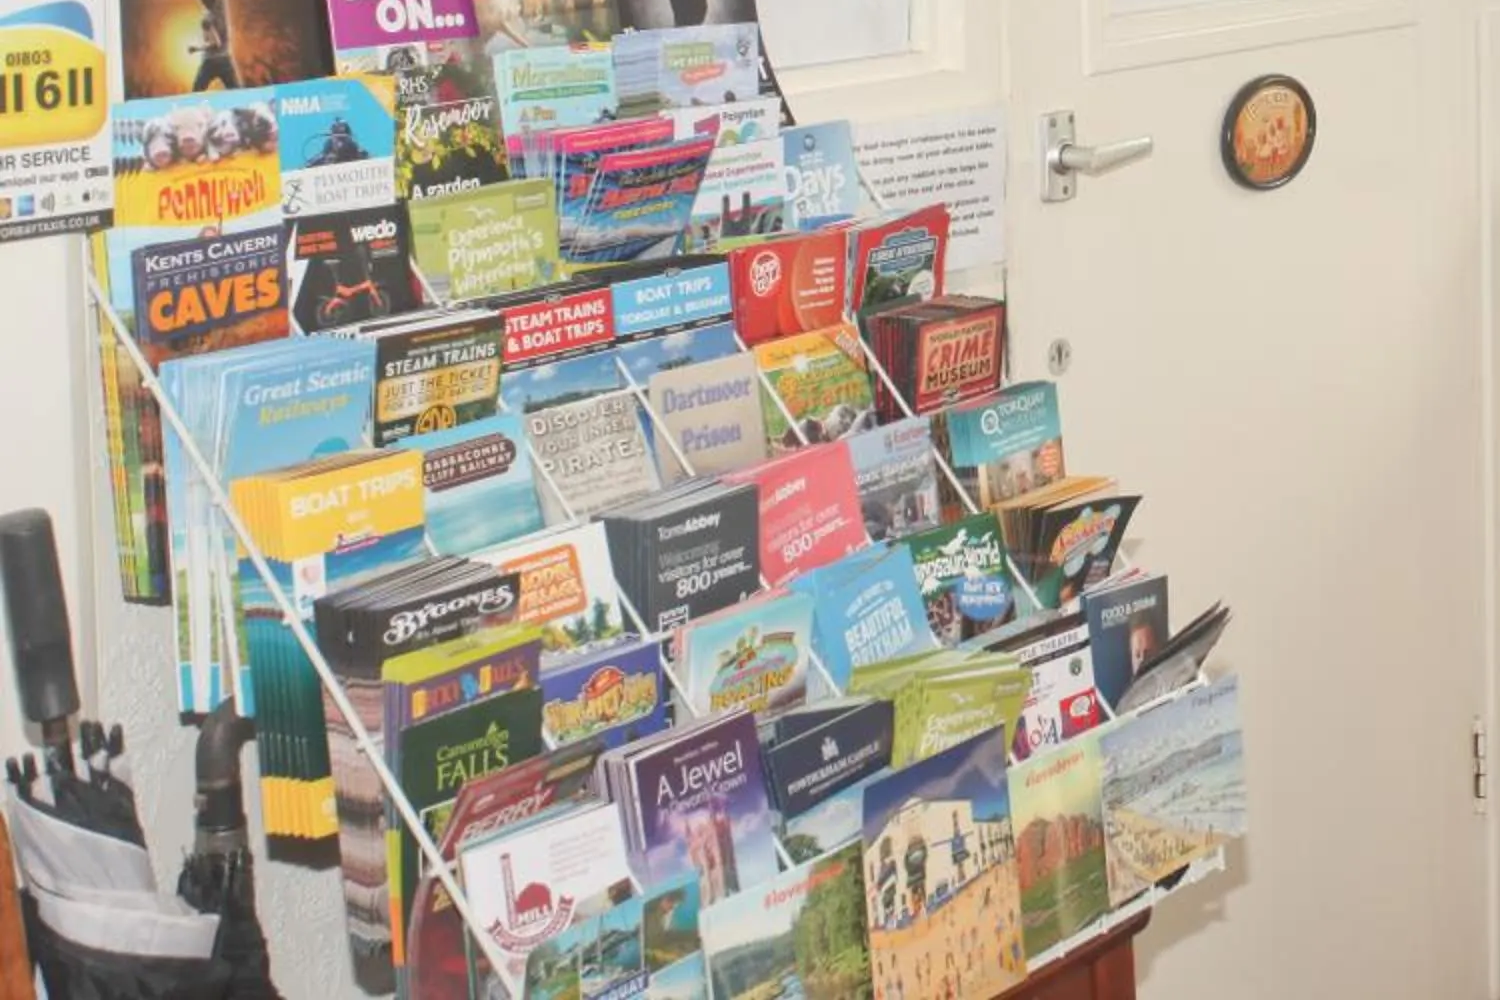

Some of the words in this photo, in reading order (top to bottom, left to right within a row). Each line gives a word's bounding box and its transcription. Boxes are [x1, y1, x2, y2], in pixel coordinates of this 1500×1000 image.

[6, 51, 52, 67] 01803
[399, 78, 428, 94] RHS
[282, 96, 320, 116] NMA
[21, 146, 91, 168] SERVICE
[314, 166, 390, 188] PLYMOUTH
[412, 184, 423, 200] A
[426, 176, 481, 197] garden
[351, 219, 397, 243] wedo
[145, 249, 204, 273] KENTS
[207, 233, 278, 260] CAVERN
[147, 253, 281, 291] PREHISTORIC
[149, 267, 282, 332] CAVES
[635, 285, 672, 304] BOAT
[678, 277, 712, 295] TRIPS
[505, 312, 553, 336] STEAM
[555, 299, 605, 320] TRAINS
[507, 337, 521, 352] &
[521, 328, 564, 350] BOAT
[565, 319, 605, 340] TRIPS
[926, 331, 994, 373] CRIME
[384, 355, 437, 377] STEAM
[443, 342, 497, 364] TRAINS
[926, 359, 991, 392] MUSEUM
[244, 380, 304, 406] Great
[307, 362, 370, 392] Scenic
[662, 377, 751, 414] Dartmoor
[531, 400, 624, 436] DISCOVER
[679, 422, 742, 453] Prison
[425, 442, 507, 473] BABBACOMBE
[459, 452, 513, 477] RAILWAY
[290, 485, 351, 519] BOAT
[357, 468, 417, 501] TRIPS
[782, 537, 813, 562] 800
[657, 558, 701, 585] visitors
[702, 551, 717, 569] for
[719, 548, 745, 564] over
[676, 572, 711, 598] 800
[383, 584, 514, 645] BYGONES
[1101, 604, 1125, 621] FOOD
[436, 746, 510, 791] FALLS
[657, 775, 673, 804] A
[680, 741, 743, 789] Jewel
[711, 773, 746, 796] Crown
